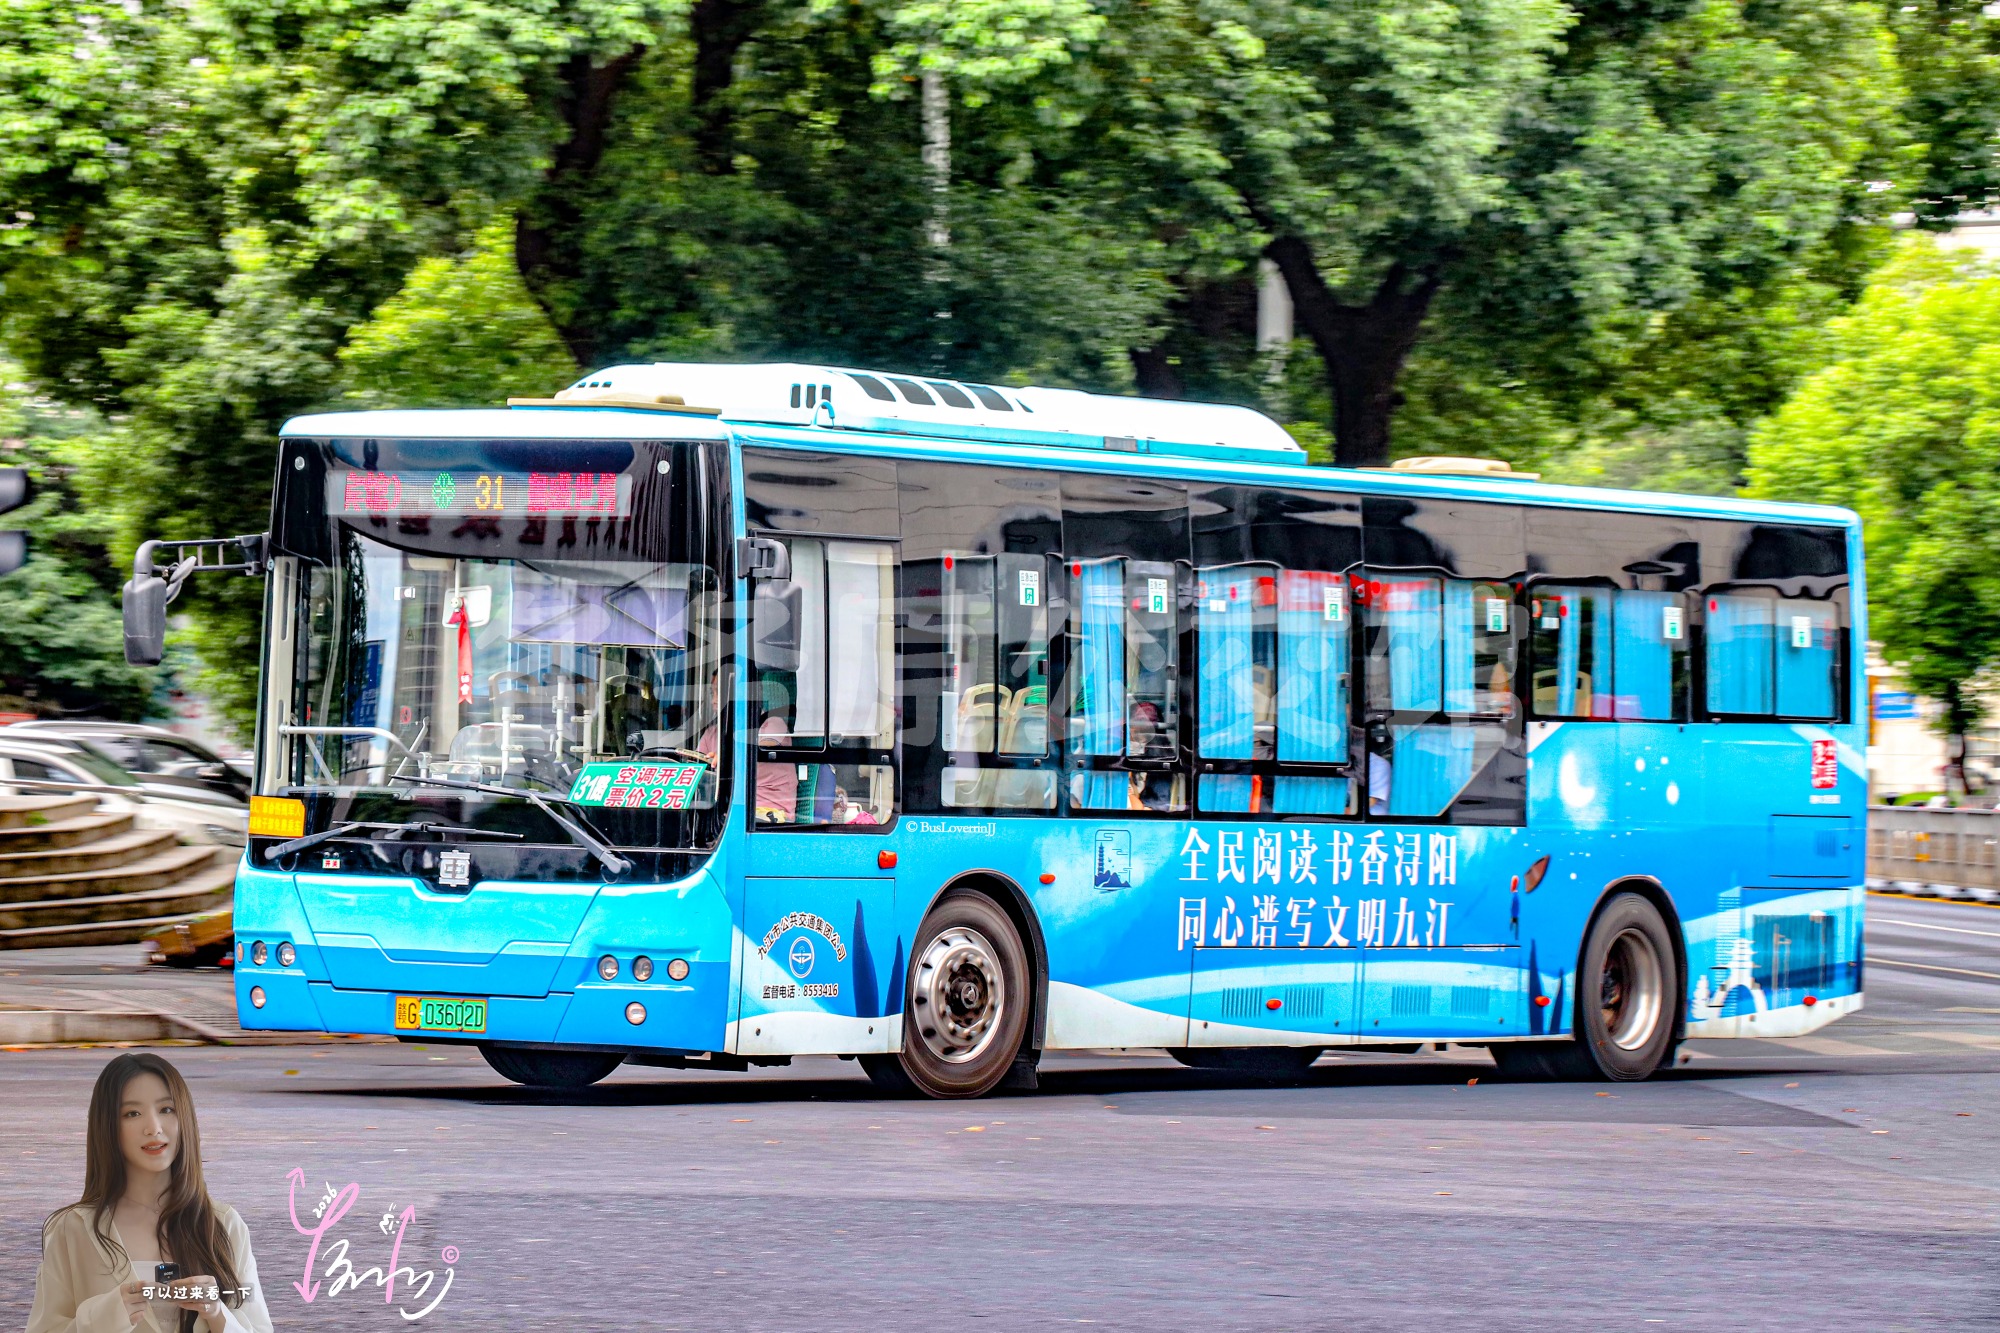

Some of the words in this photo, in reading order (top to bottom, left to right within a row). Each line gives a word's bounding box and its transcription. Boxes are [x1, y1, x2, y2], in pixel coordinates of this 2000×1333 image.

[474, 475, 505, 510] 31
[614, 767, 698, 786] 空调开启
[605, 787, 686, 809] 票价2元
[1179, 826, 1458, 886] 全民阅读书香浔阳
[757, 912, 847, 961] 九江市公共交通集团公司
[1177, 894, 1456, 951] 同心谱写文明九江
[425, 1003, 484, 1027] 03602D
